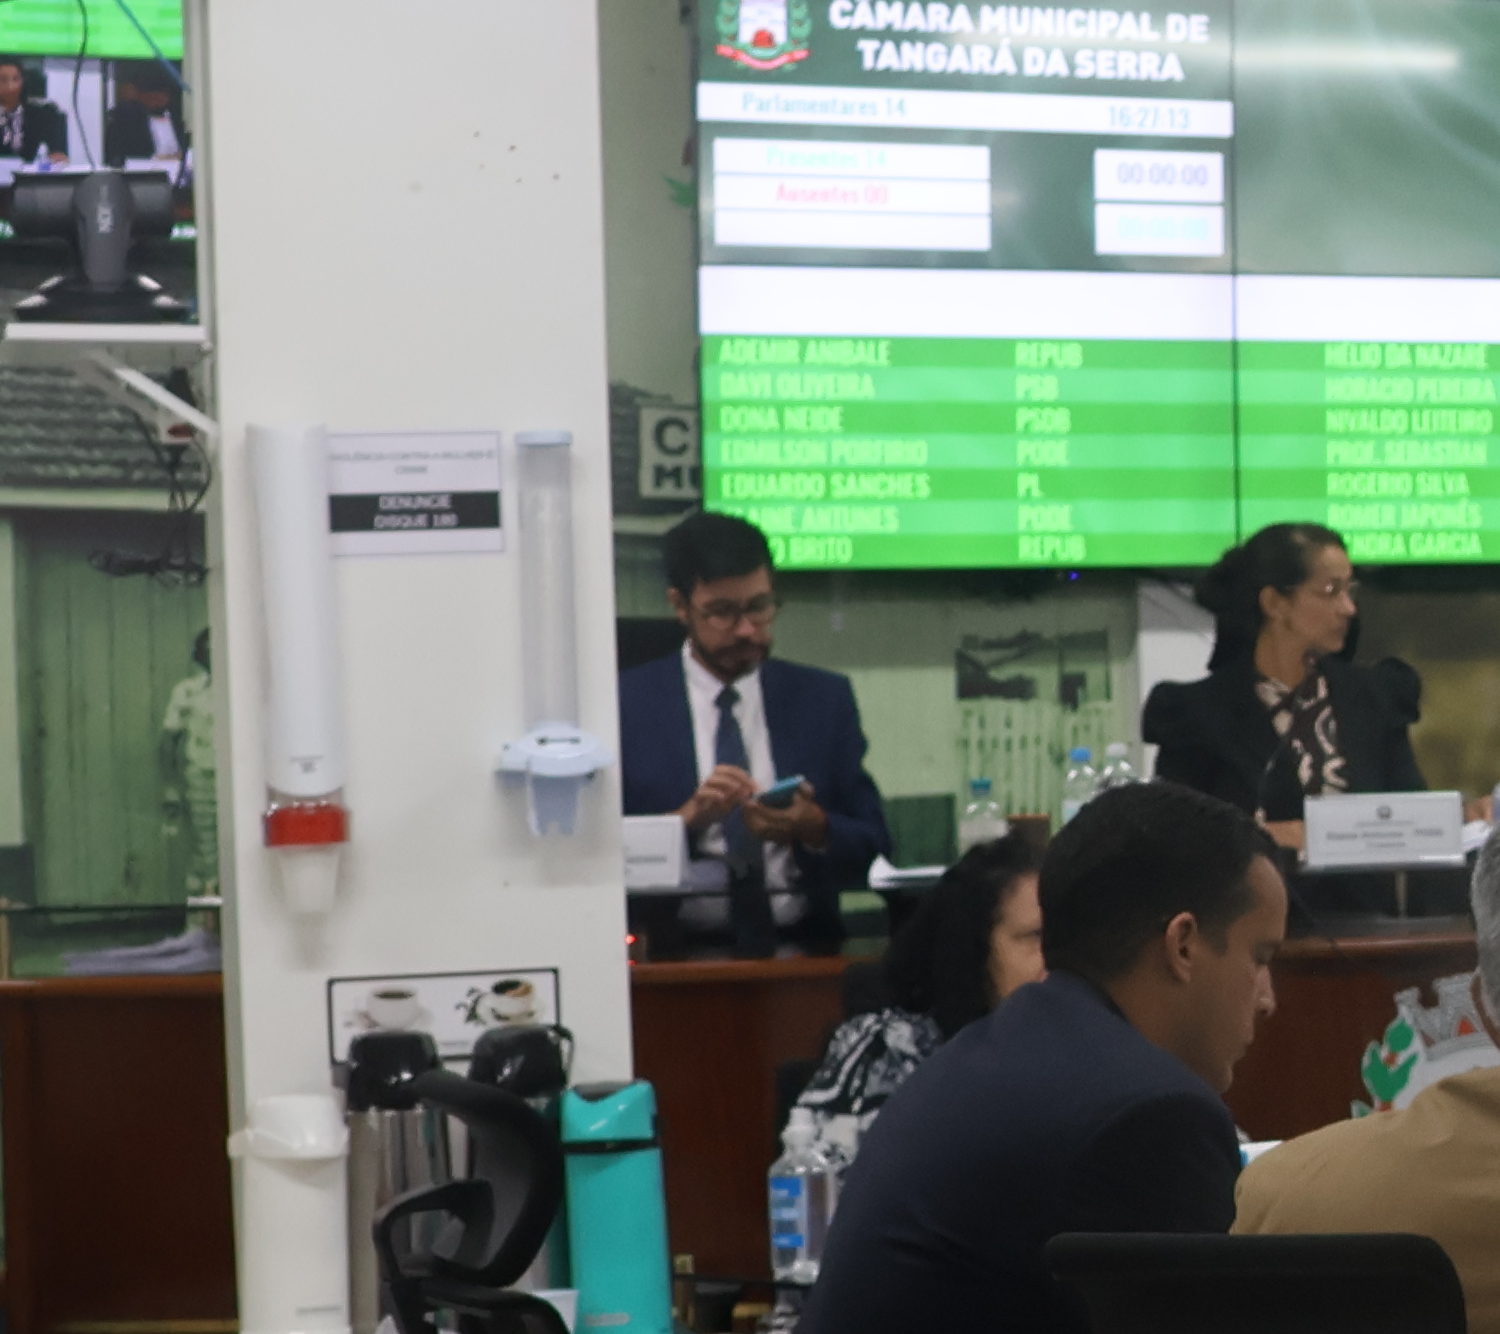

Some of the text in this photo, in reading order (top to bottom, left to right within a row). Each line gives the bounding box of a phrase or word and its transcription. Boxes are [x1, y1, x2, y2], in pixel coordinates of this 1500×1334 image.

[980, 4, 1158, 41] MUNICIPAL
[1165, 14, 1210, 43] DE
[857, 38, 1185, 81] TANGARÁ DA SERRA
[742, 92, 906, 118] Parlamentares 14
[767, 147, 886, 167] Presentes 14
[777, 184, 860, 204] Ausentes
[721, 472, 826, 499] EDUARDO
